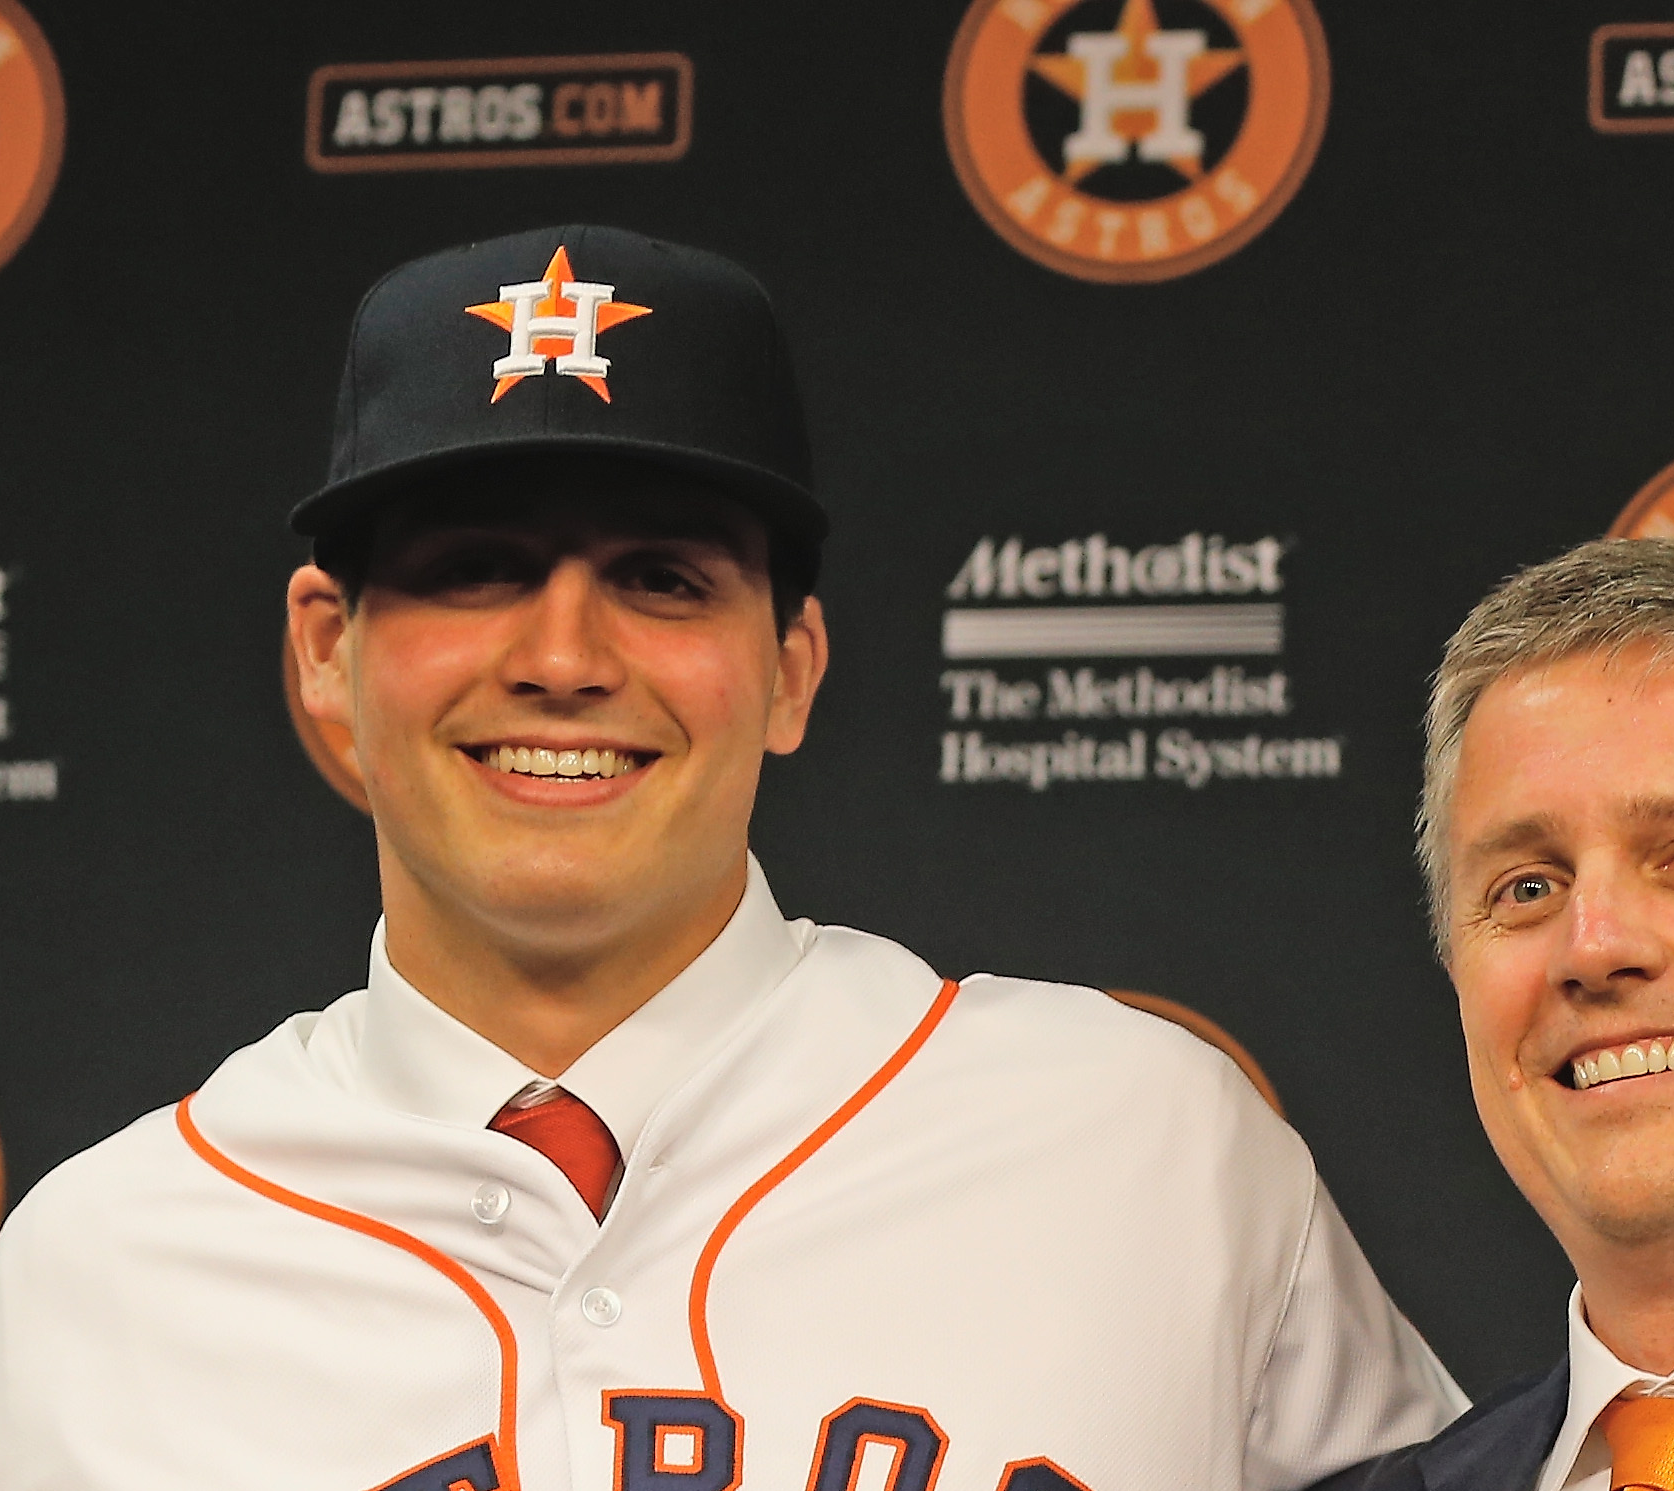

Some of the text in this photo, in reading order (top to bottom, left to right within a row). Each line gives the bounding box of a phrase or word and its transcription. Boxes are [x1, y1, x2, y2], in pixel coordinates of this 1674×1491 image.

[334, 82, 665, 148] ASTROS.COM
[1061, 28, 1206, 164] H
[1006, 168, 1262, 258] ASTROS
[492, 278, 614, 381] H
[946, 530, 1286, 600] Methodist
[939, 664, 1293, 722] The Methodist
[939, 726, 1343, 792] Hospital System
